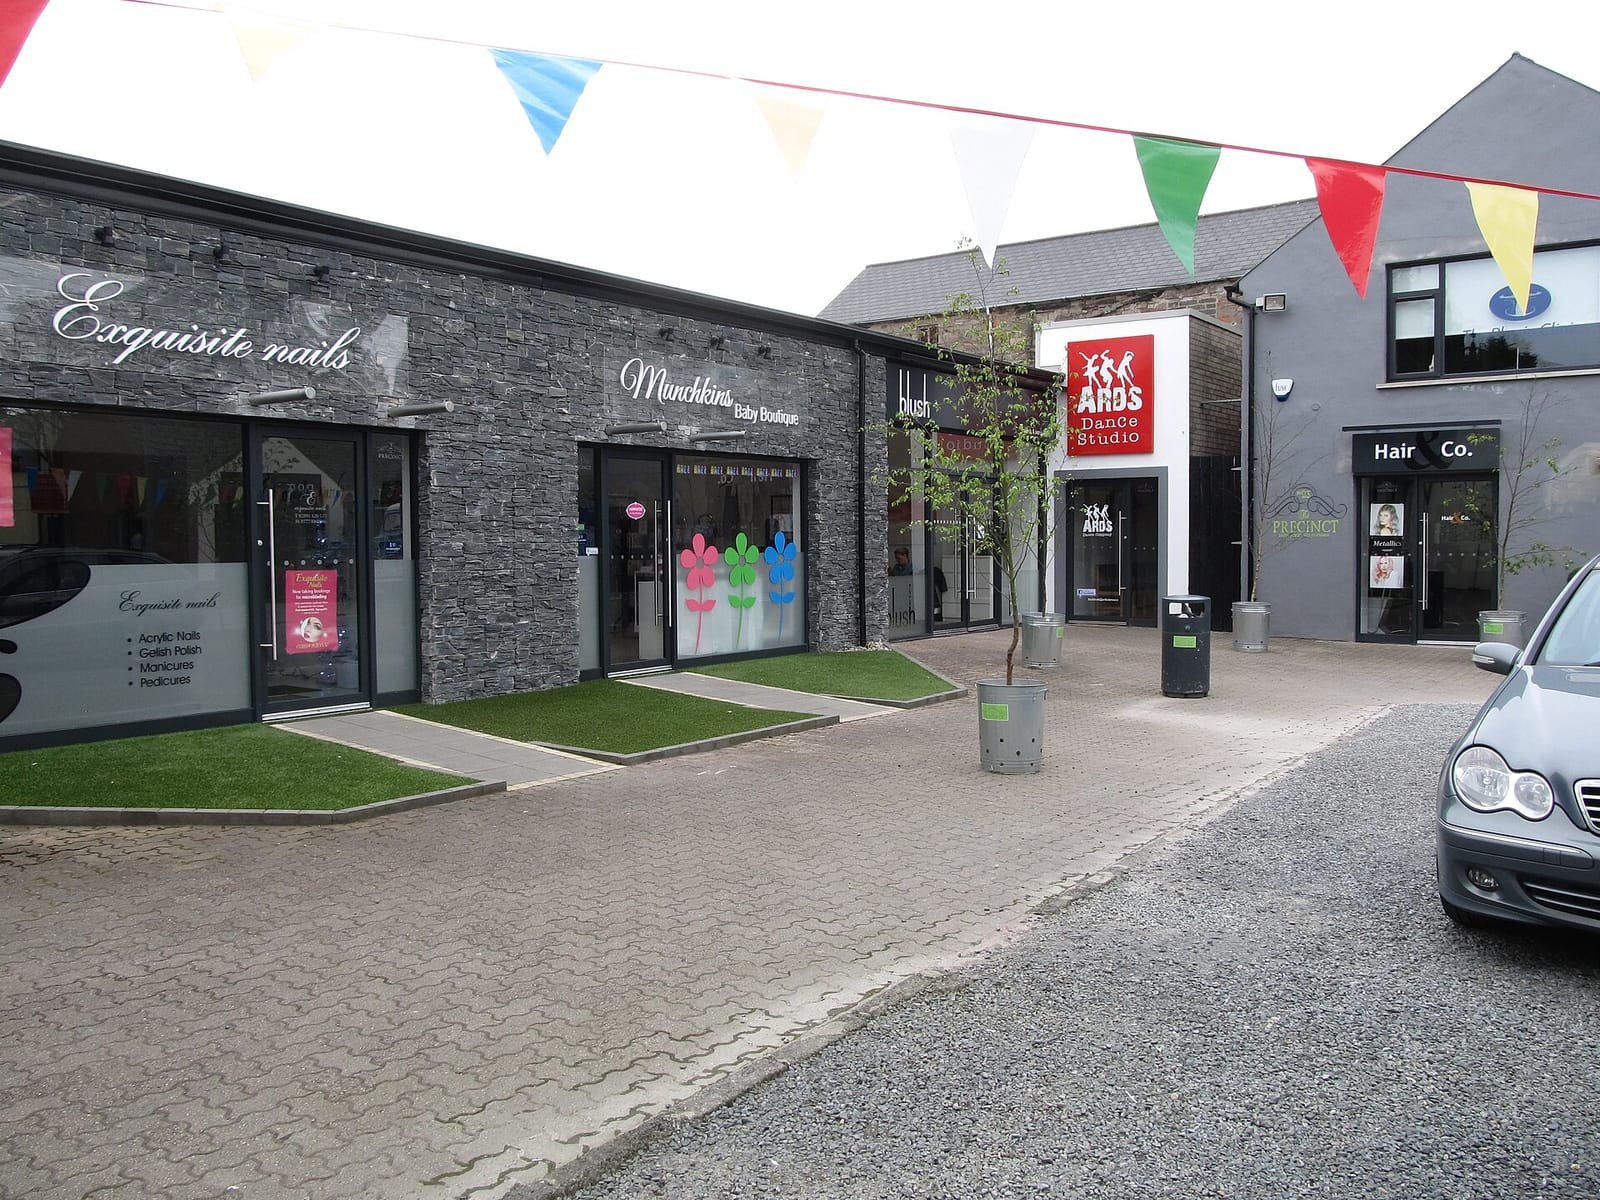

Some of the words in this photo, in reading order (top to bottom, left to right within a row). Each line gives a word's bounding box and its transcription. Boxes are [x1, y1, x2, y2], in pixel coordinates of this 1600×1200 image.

[53, 272, 254, 364] Exquisite
[261, 327, 361, 370] nails
[620, 358, 733, 407] Munchkins
[899, 369, 930, 418] blush
[1077, 386, 1143, 413] ARDS
[734, 403, 758, 423] Baby
[760, 406, 799, 427] Boutique
[1081, 416, 1138, 430] Dance
[1077, 431, 1140, 446] Studio
[1375, 443, 1416, 460] Hair
[1441, 441, 1473, 458] Co.
[1083, 519, 1113, 533] ARDS
[1273, 520, 1339, 533] PRECINCT
[119, 590, 181, 616] Exquisite
[185, 591, 221, 609] nails
[138, 632, 173, 644] Acrylic
[176, 630, 200, 641] Nails
[139, 647, 172, 658] Gelish
[174, 645, 202, 656] Polish
[140, 660, 194, 673] Manicures
[140, 675, 191, 687] Pedicures
